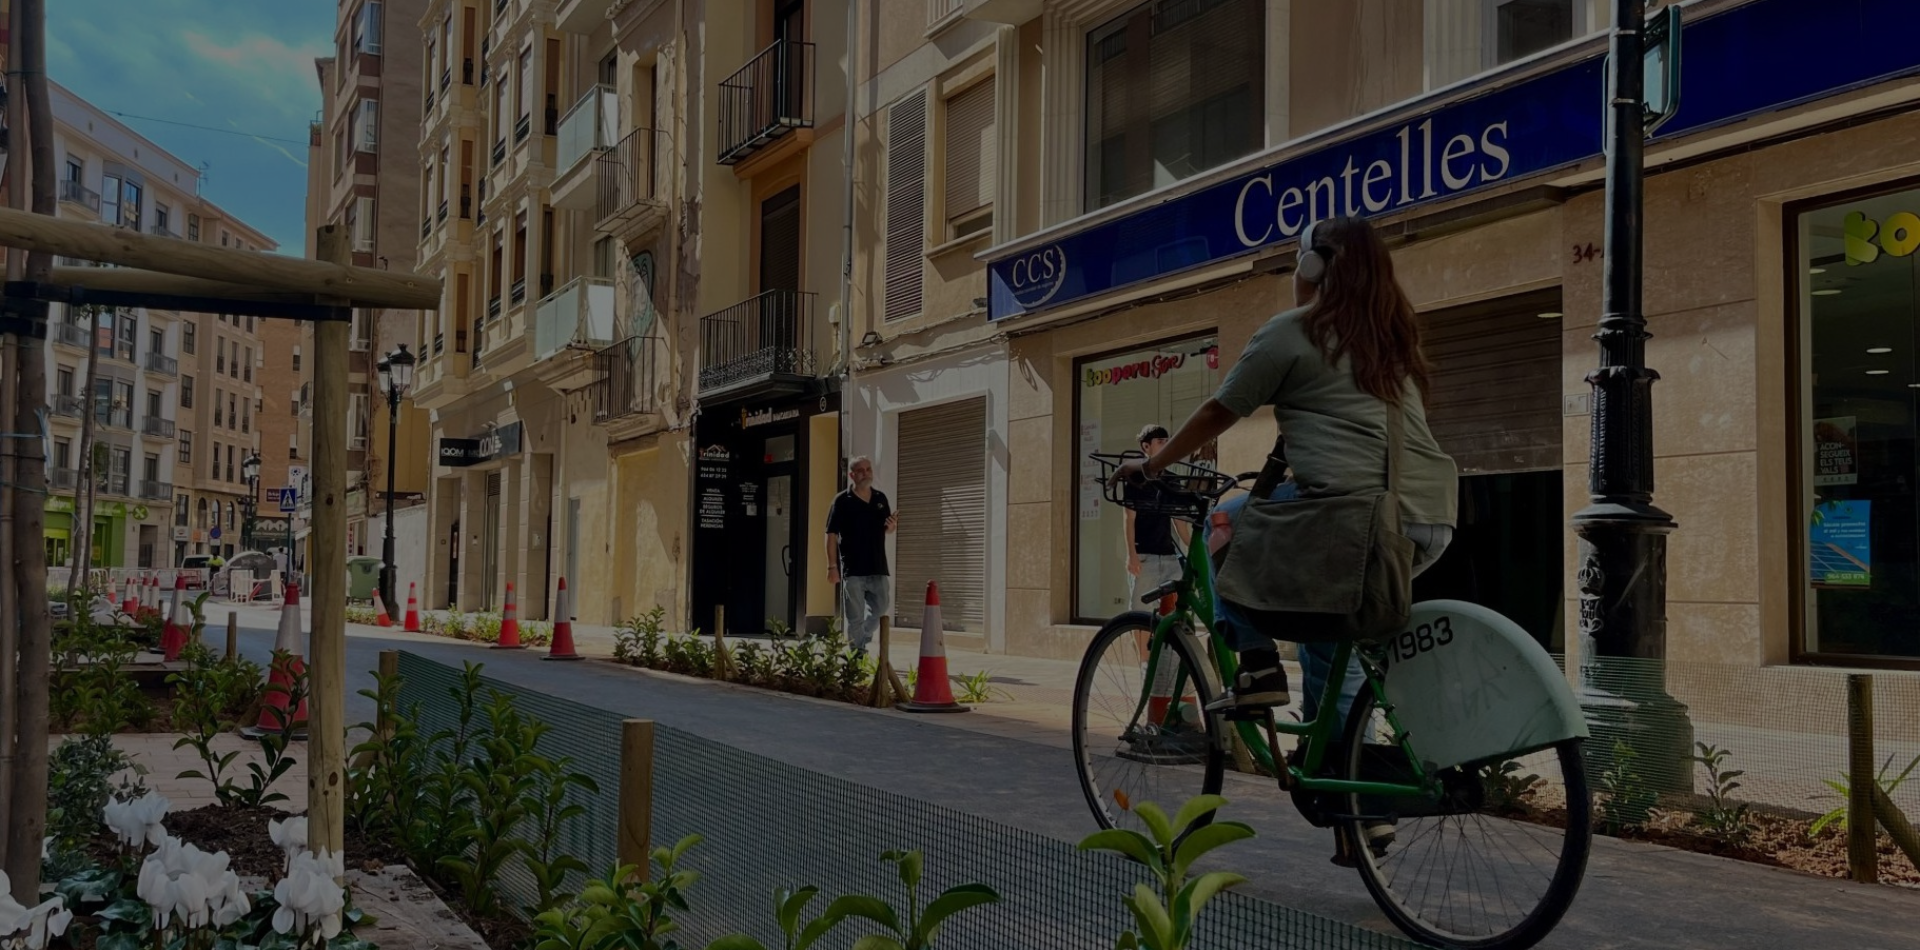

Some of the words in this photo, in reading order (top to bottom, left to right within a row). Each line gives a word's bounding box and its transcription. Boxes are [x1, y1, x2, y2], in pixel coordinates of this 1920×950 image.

[1234, 117, 1511, 248] Centelles
[1012, 248, 1055, 288] CCS
[1387, 616, 1453, 663] 1983
